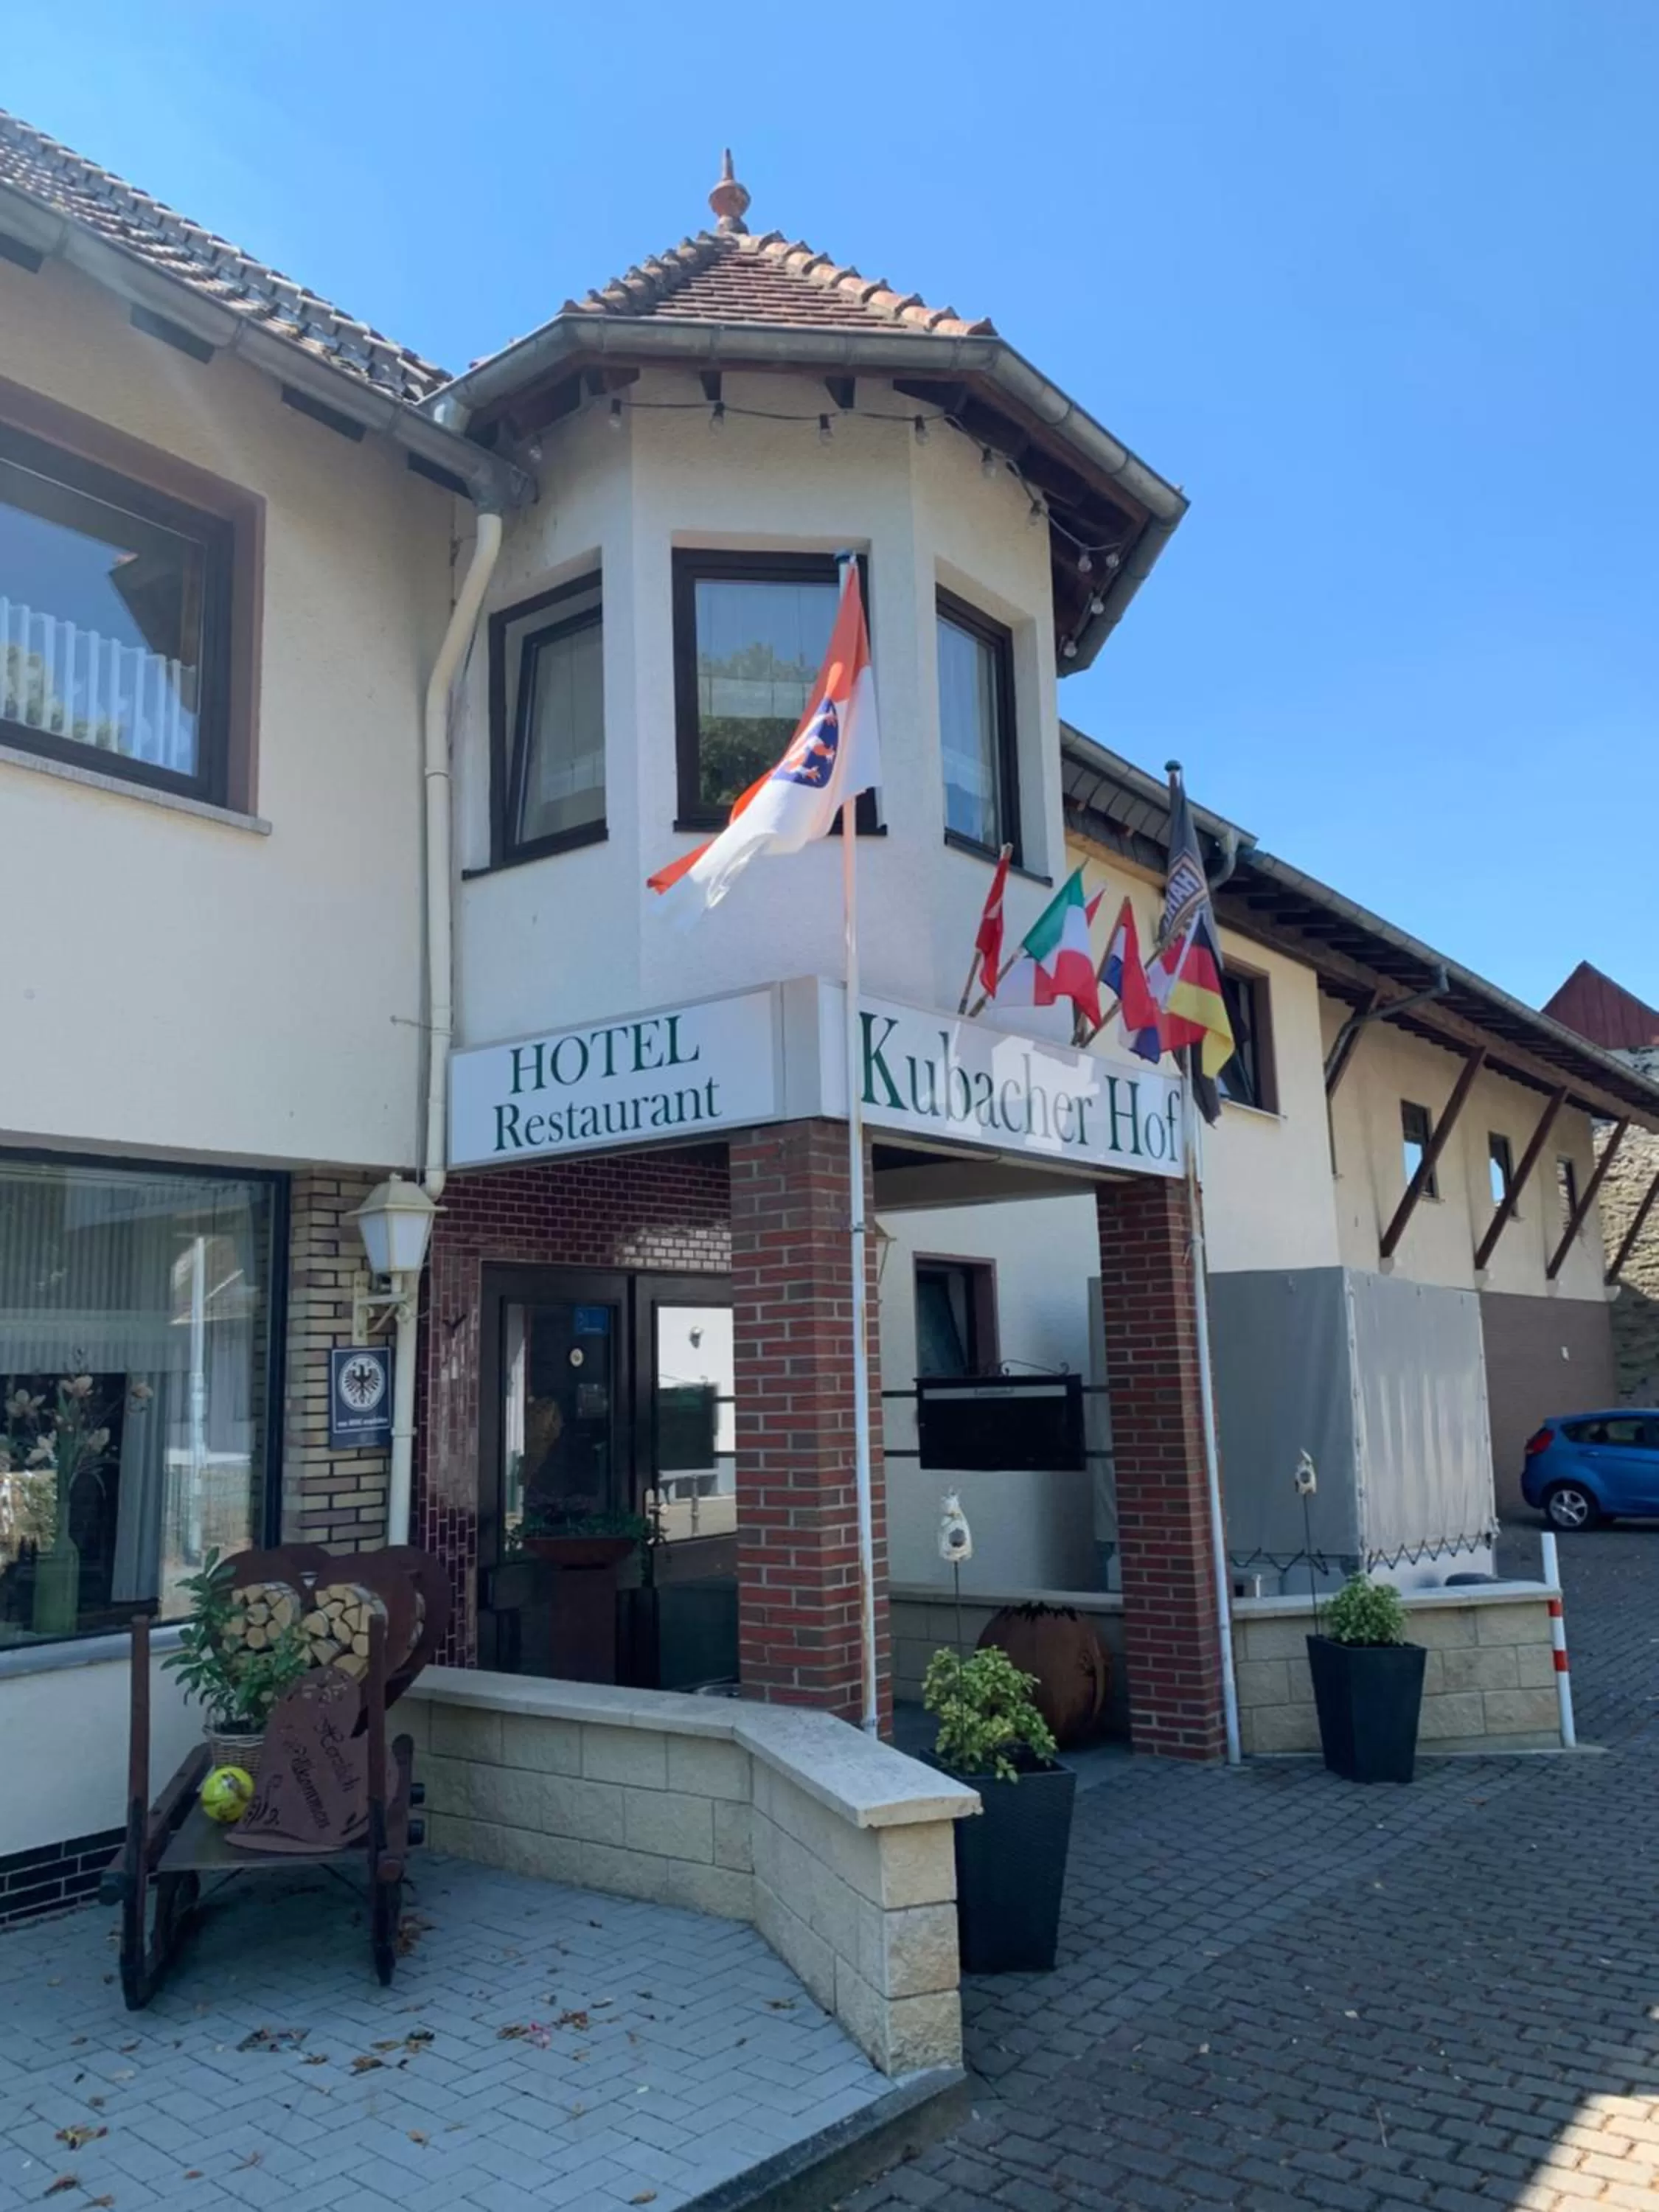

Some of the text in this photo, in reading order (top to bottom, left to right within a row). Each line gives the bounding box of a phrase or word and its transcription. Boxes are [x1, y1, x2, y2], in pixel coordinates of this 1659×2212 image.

[509, 1015, 700, 1095] HOTEL
[858, 1011, 1180, 1163] Kubacher Hof
[493, 1077, 723, 1152] Restaurant
